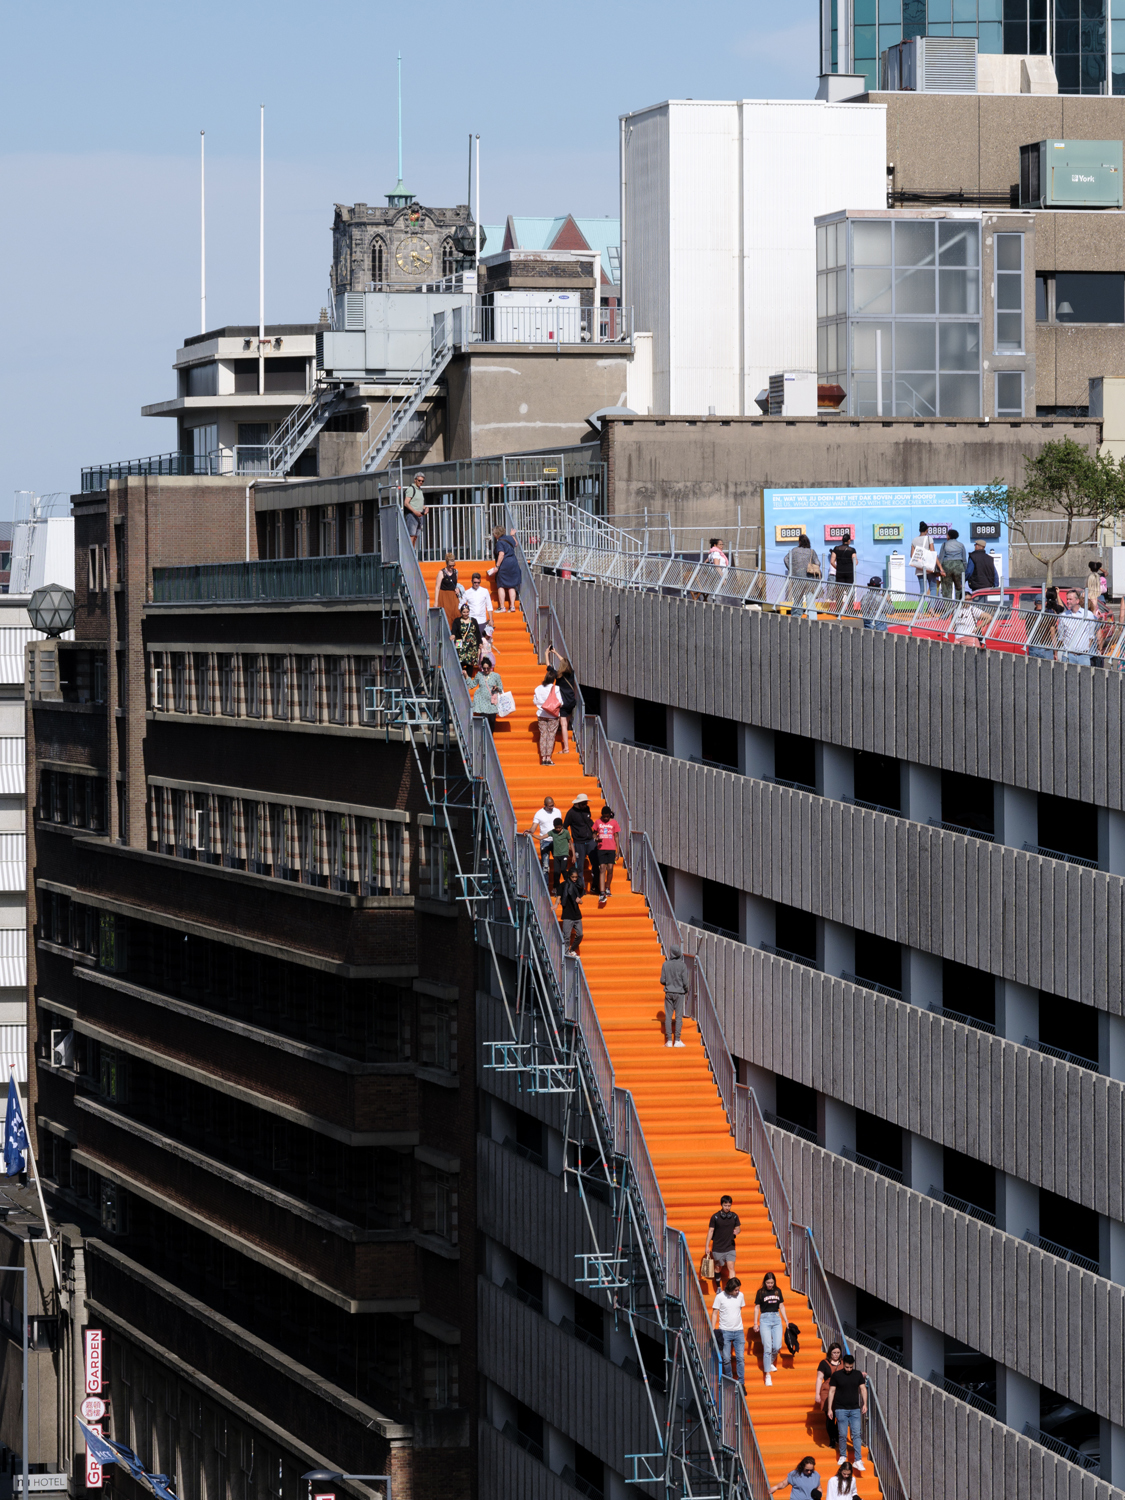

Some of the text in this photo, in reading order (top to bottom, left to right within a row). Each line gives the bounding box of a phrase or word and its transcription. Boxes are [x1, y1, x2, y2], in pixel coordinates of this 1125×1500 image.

[88, 1333, 99, 1392] GARDEN
[34, 1478, 65, 1486] HOTEL
[88, 1428, 100, 1484] GRD
